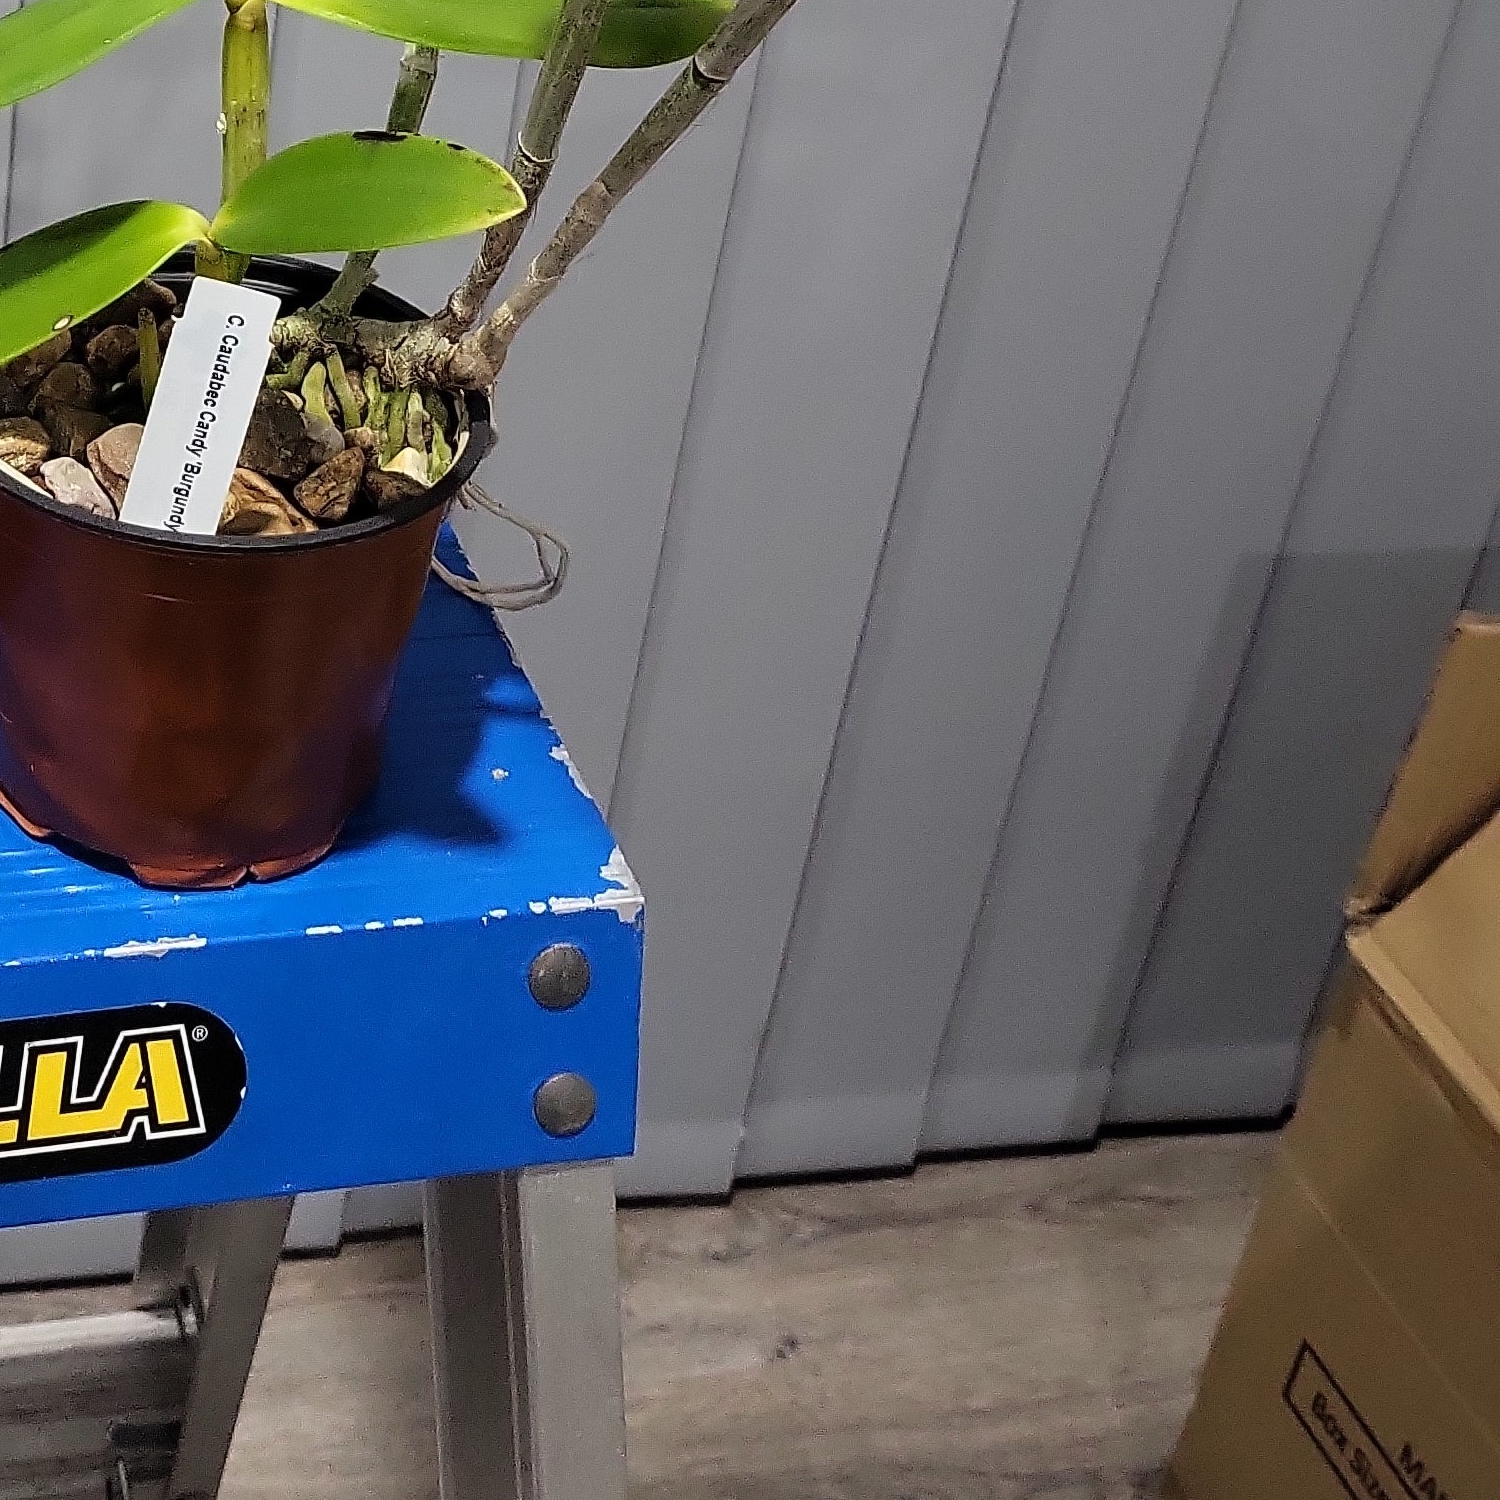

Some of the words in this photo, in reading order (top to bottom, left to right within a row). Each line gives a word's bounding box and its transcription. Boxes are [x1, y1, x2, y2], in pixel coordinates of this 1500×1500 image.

[225, 314, 245, 329] C.
[203, 333, 239, 408] Caudabec
[185, 410, 217, 458] Candy
